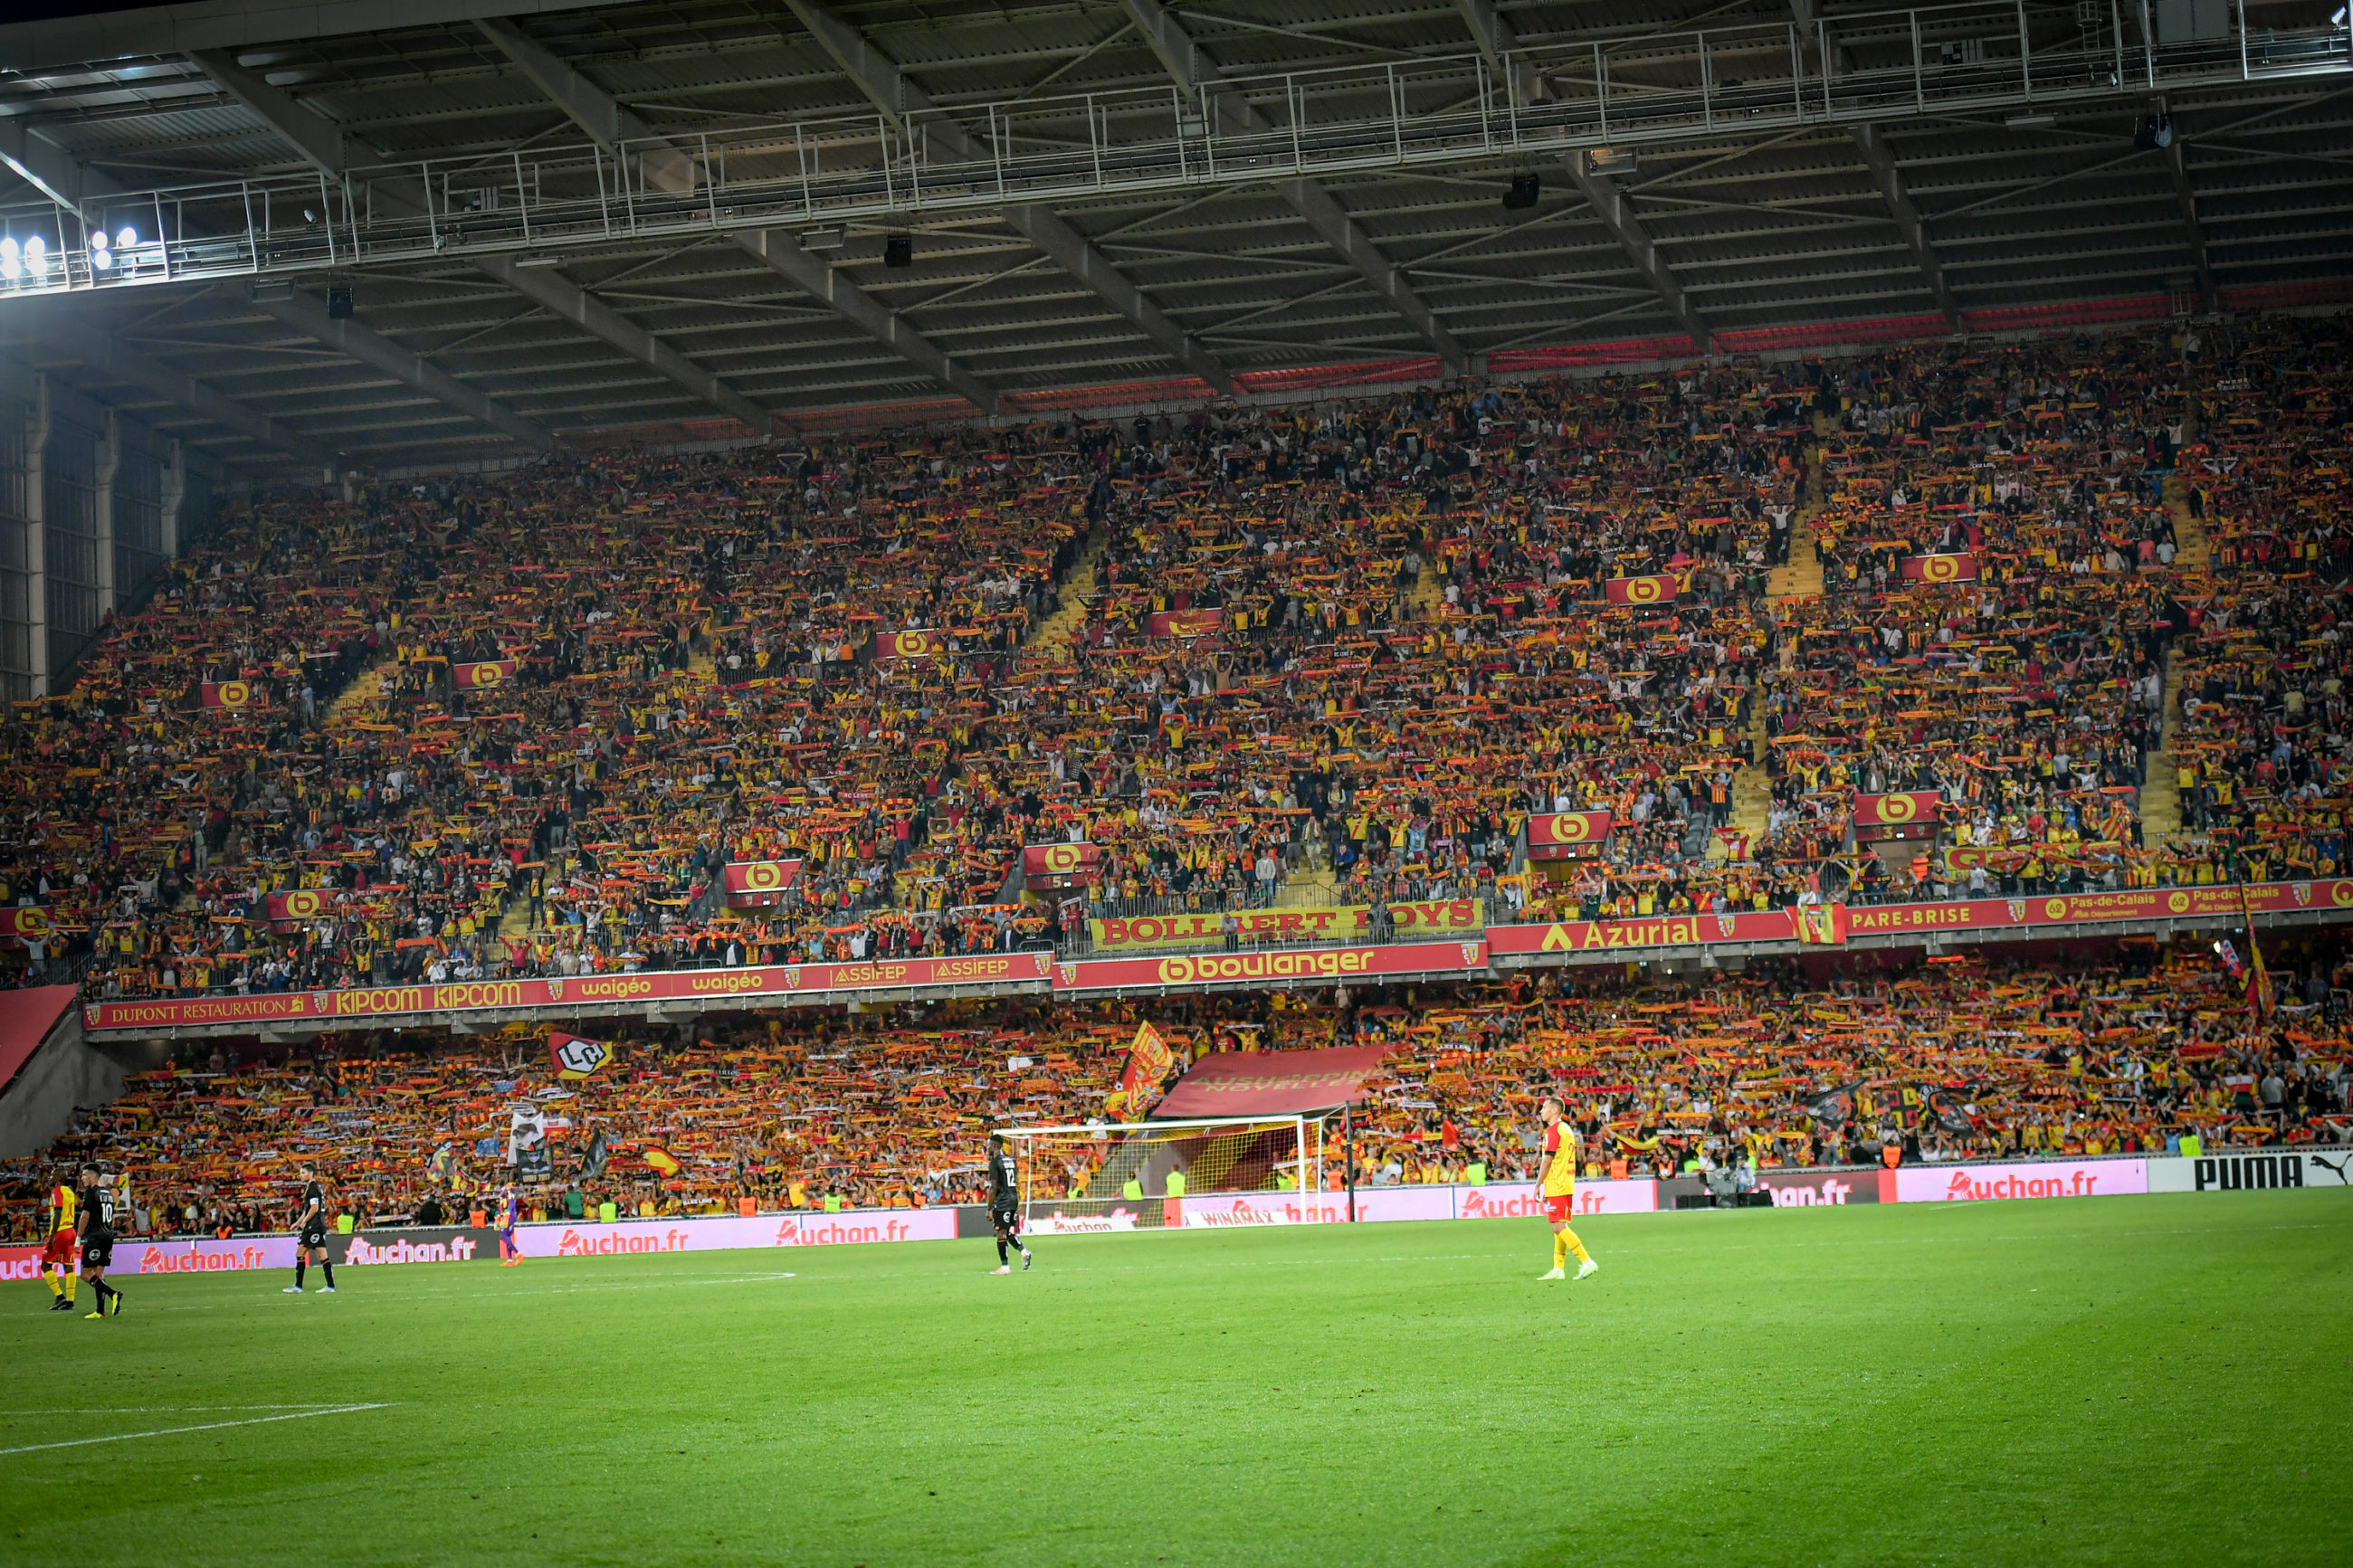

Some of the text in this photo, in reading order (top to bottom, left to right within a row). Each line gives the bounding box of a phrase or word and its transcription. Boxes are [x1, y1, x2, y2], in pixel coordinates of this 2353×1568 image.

[2049, 902, 2062, 916] 62
[2171, 896, 2186, 908] 62
[2214, 899, 2262, 913] Départeent
[1852, 908, 1970, 928] PARE-BRISE
[1584, 917, 1700, 948] Azurial
[1198, 950, 1375, 978] boulanger
[581, 977, 652, 998] waigéo
[692, 973, 763, 993] waigéo
[336, 982, 521, 1014] KIPCOM KIPCOM
[112, 1000, 286, 1022] DUPONT RESTAURATION
[1005, 1168, 1016, 1187] 12
[2195, 1155, 2302, 1191] PUMA
[1947, 1171, 2097, 1201] Auchan.fr
[101, 1202, 113, 1223] 10
[1462, 1190, 1605, 1219] Auch.fr
[1054, 1220, 1112, 1233] Auchan
[1201, 1211, 1274, 1227] WINAMAX
[558, 1228, 689, 1256] Auchan.fr
[776, 1219, 909, 1246] Auchan.fr
[139, 1245, 265, 1274] Auchan.fr
[345, 1235, 477, 1266] Auchan.fr
